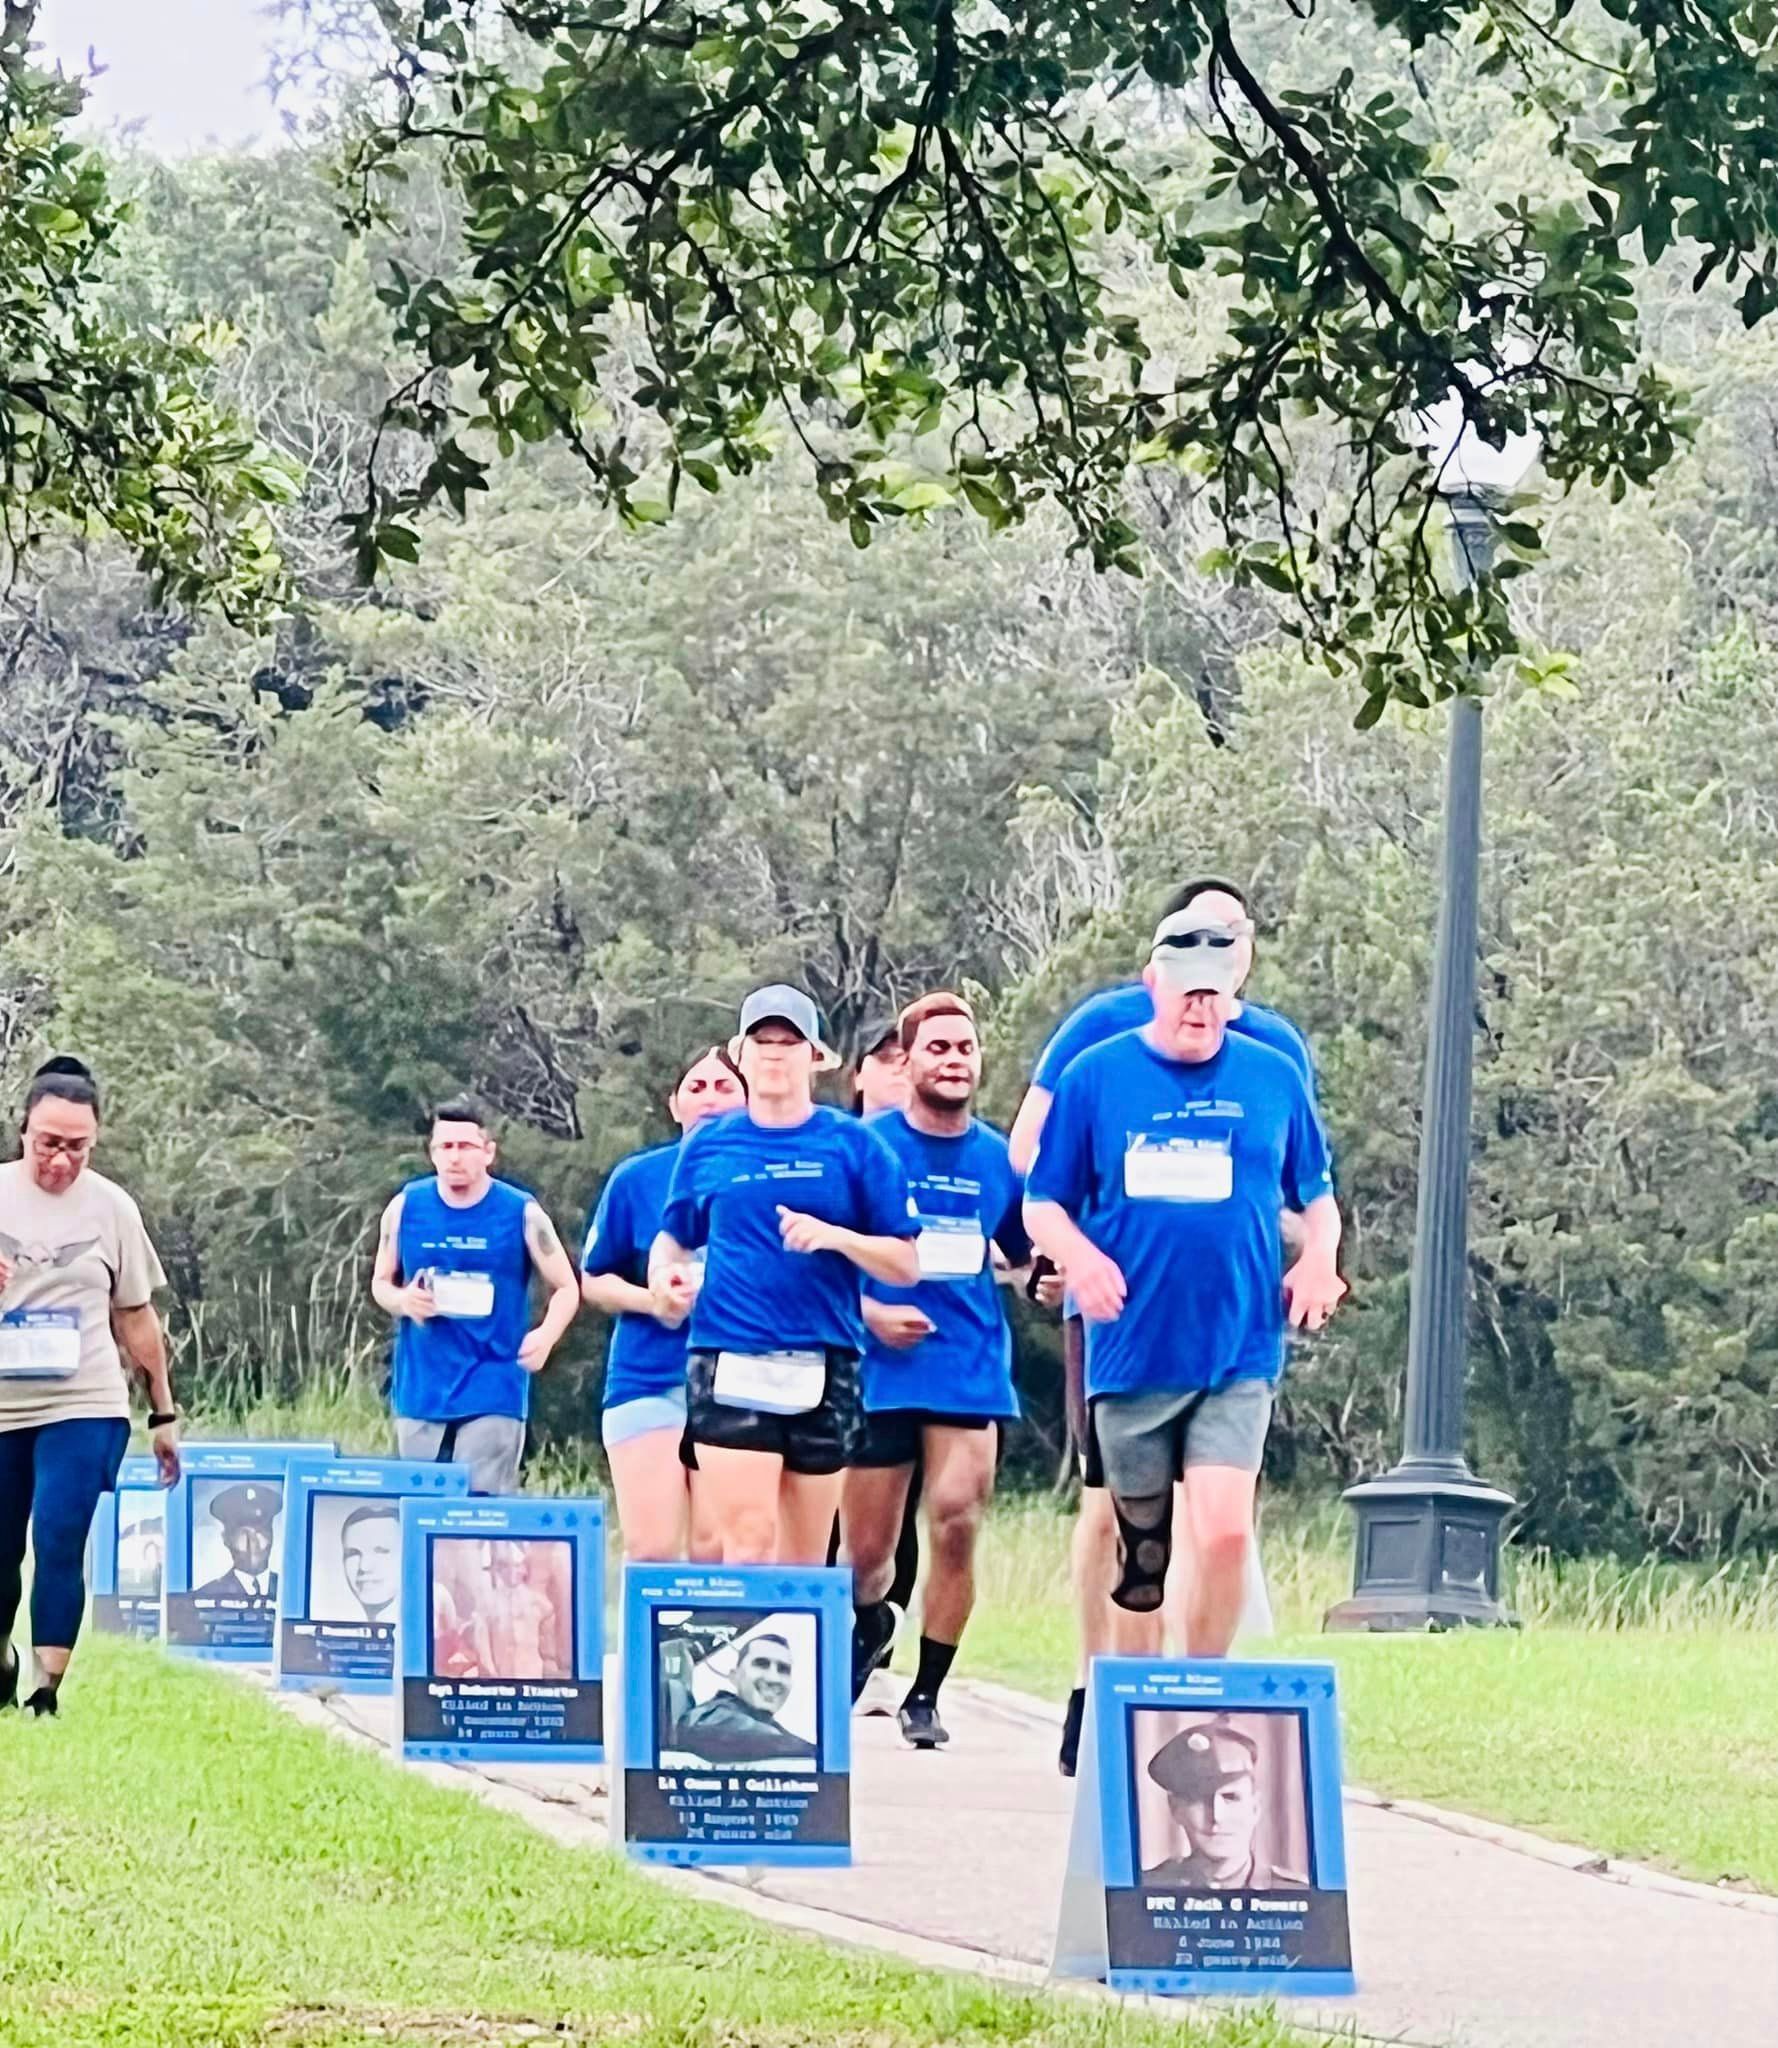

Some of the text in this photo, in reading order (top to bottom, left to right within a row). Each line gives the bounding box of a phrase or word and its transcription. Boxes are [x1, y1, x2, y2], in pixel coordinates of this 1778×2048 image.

[1153, 1916, 1304, 1930] Killed in Action
